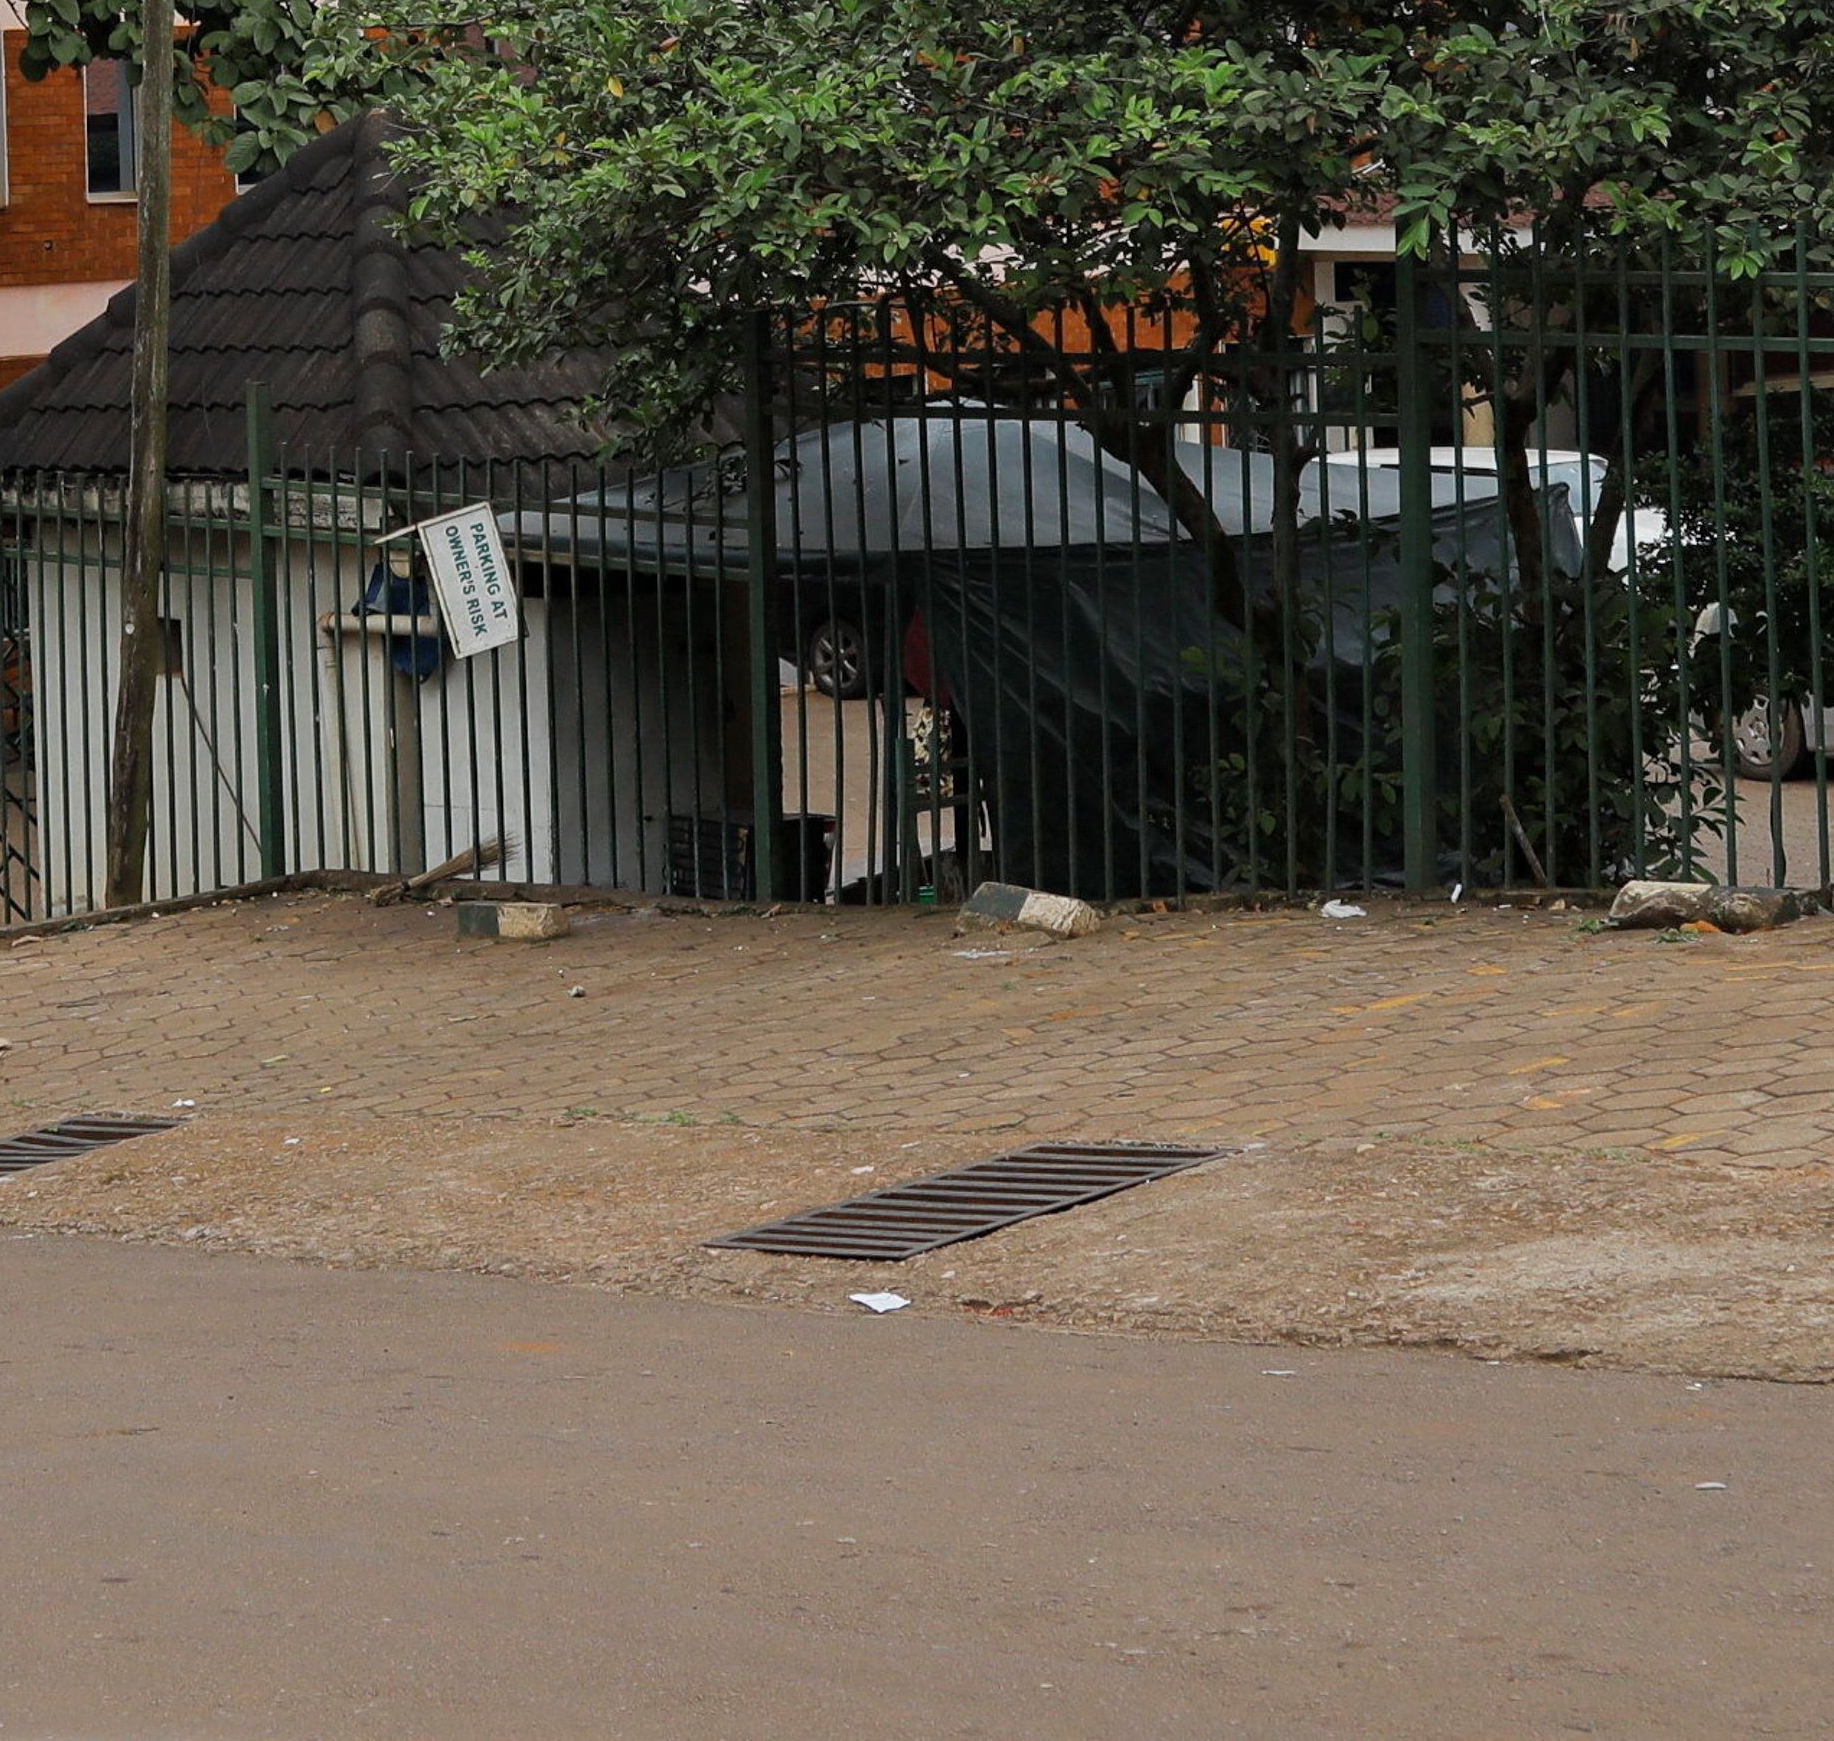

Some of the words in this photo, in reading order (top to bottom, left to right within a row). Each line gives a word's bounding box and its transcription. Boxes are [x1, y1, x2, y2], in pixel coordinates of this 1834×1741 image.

[445, 525, 476, 596] OWNER'S
[466, 598, 488, 637] RISK
[469, 522, 501, 596] PARKING
[491, 600, 508, 619] AT
